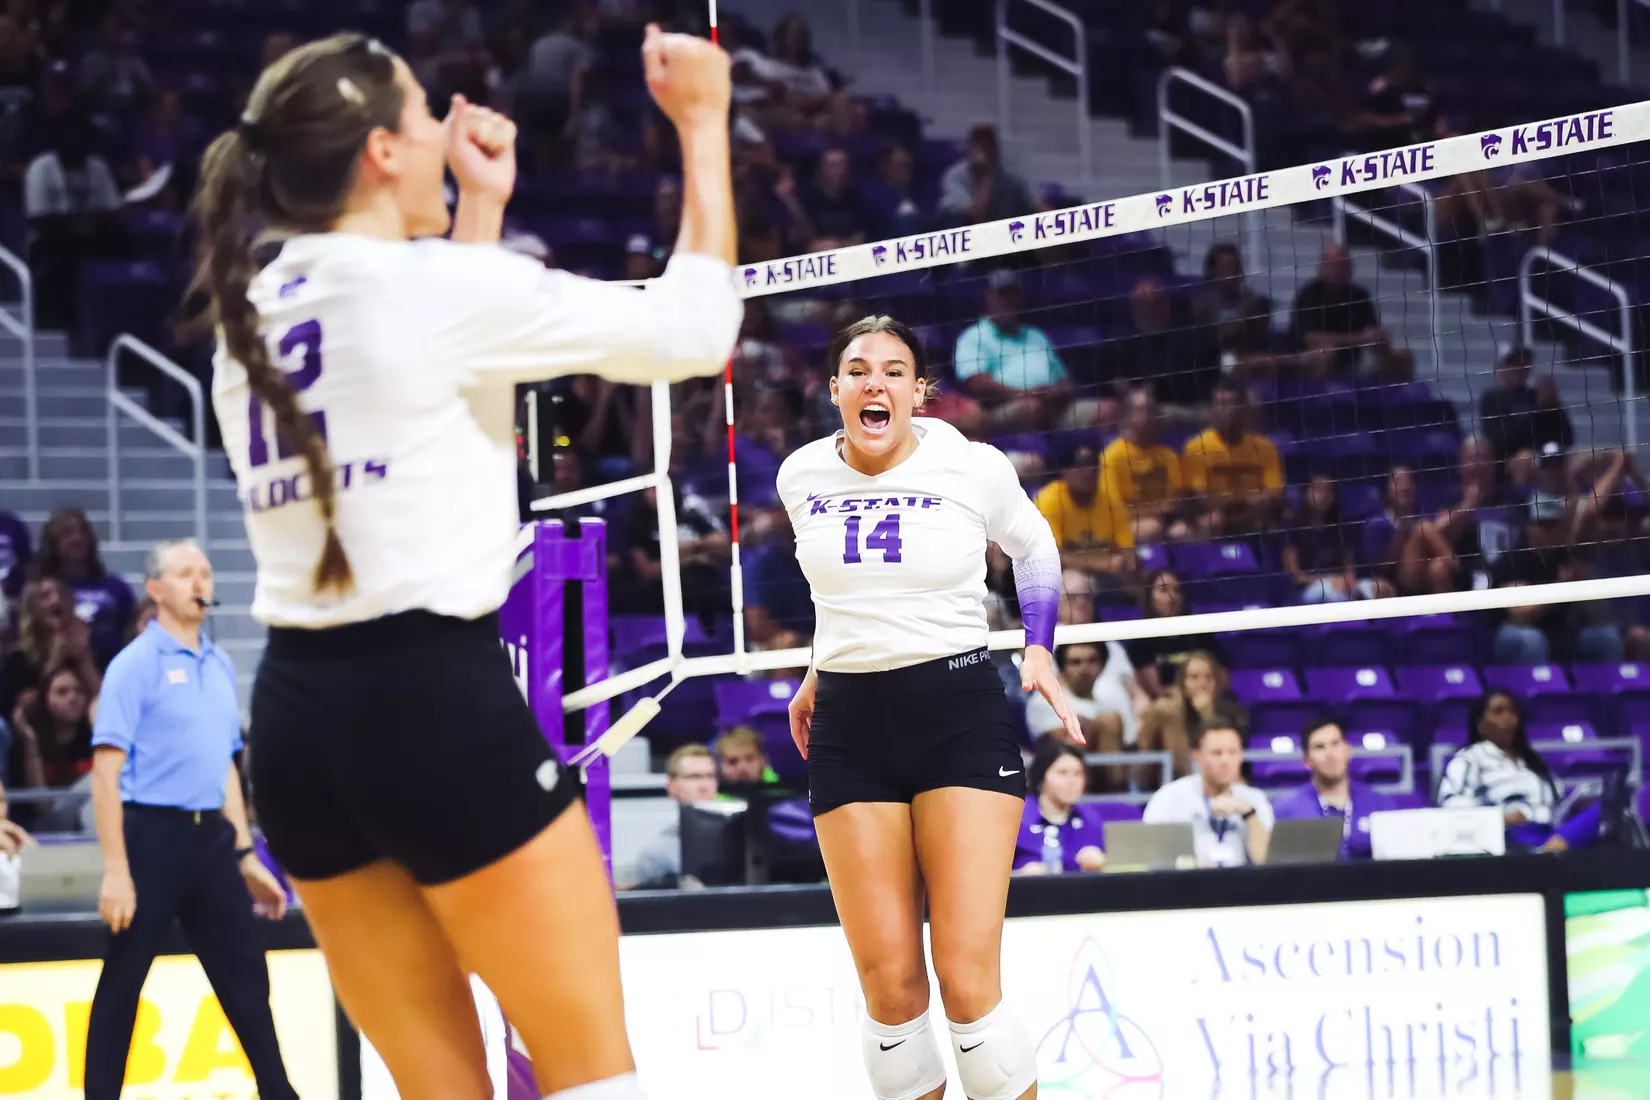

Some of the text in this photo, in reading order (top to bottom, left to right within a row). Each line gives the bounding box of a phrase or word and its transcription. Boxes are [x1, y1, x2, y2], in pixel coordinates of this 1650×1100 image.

[766, 111, 1613, 286] K-STATE K-STATE K-STATE K-STATE K-STATE K-STATE
[843, 513, 902, 564] 14
[948, 650, 991, 671] NIKE PR
[1192, 916, 1502, 983] Ascension
[1196, 998, 1522, 1073] Via Christi
